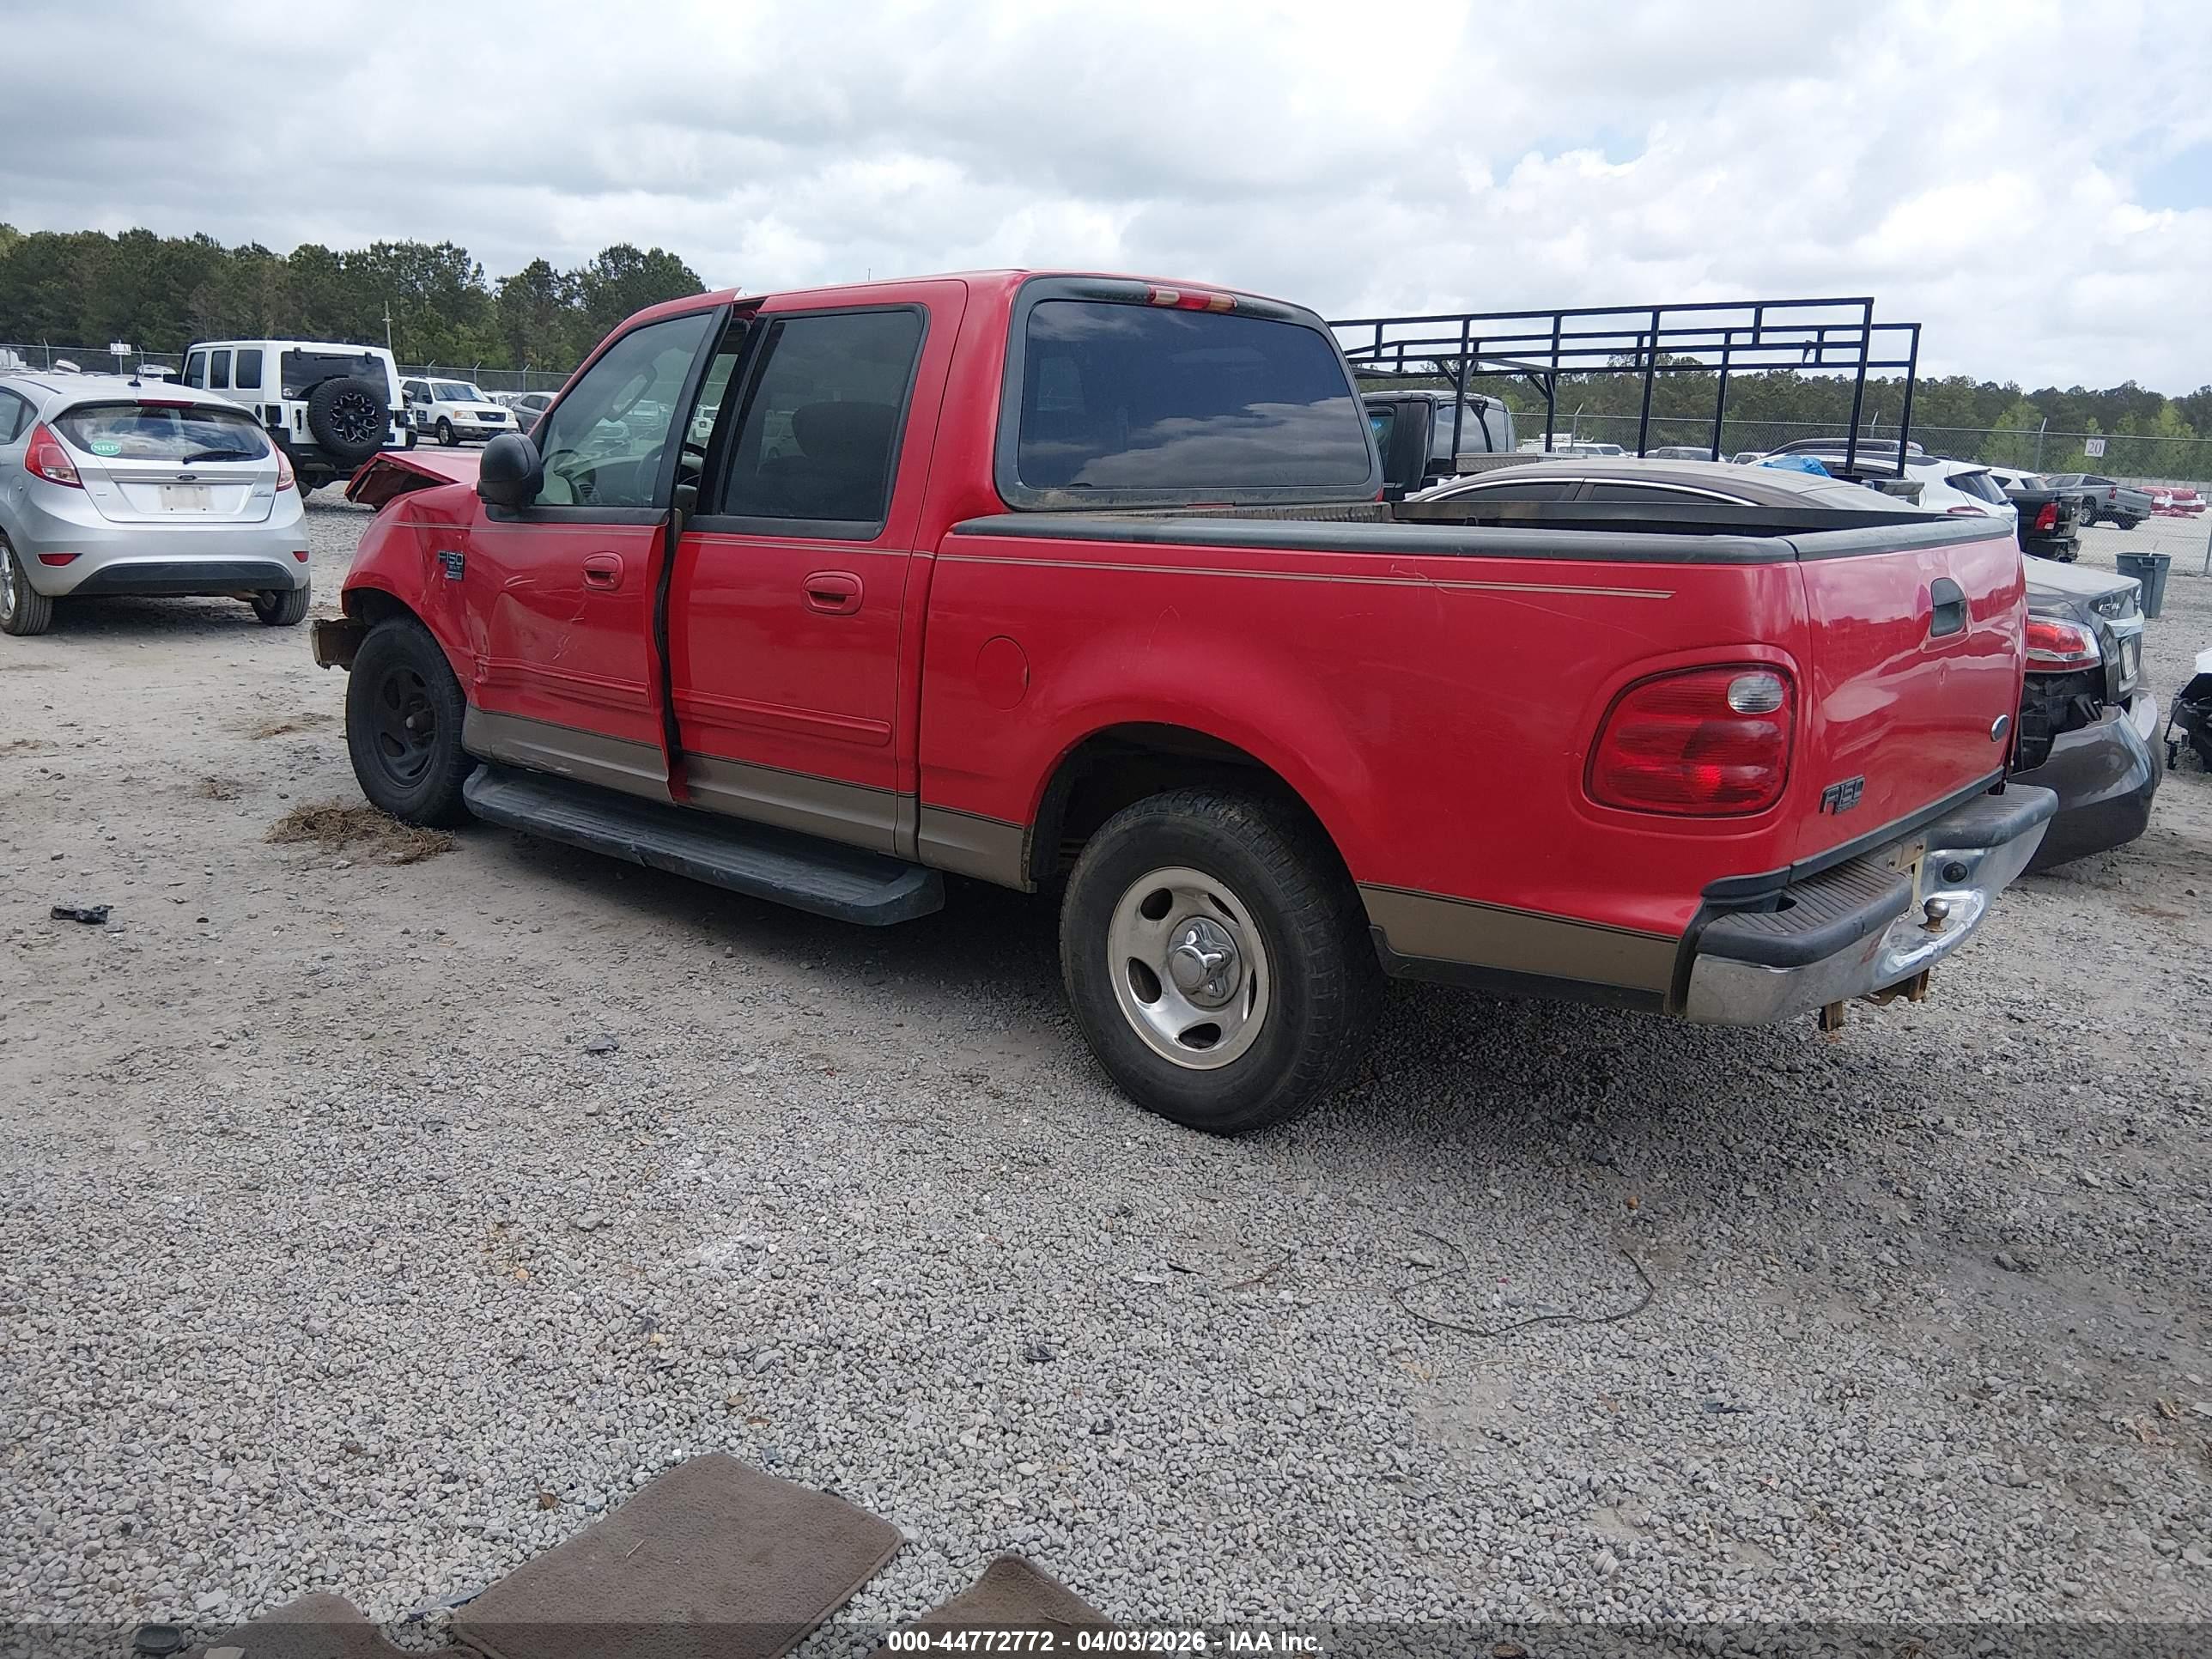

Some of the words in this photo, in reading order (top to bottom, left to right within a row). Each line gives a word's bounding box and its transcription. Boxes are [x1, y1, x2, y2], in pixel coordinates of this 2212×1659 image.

[2087, 441, 2102, 454] 20
[438, 550, 464, 566] F150
[1819, 775, 1866, 815] F150
